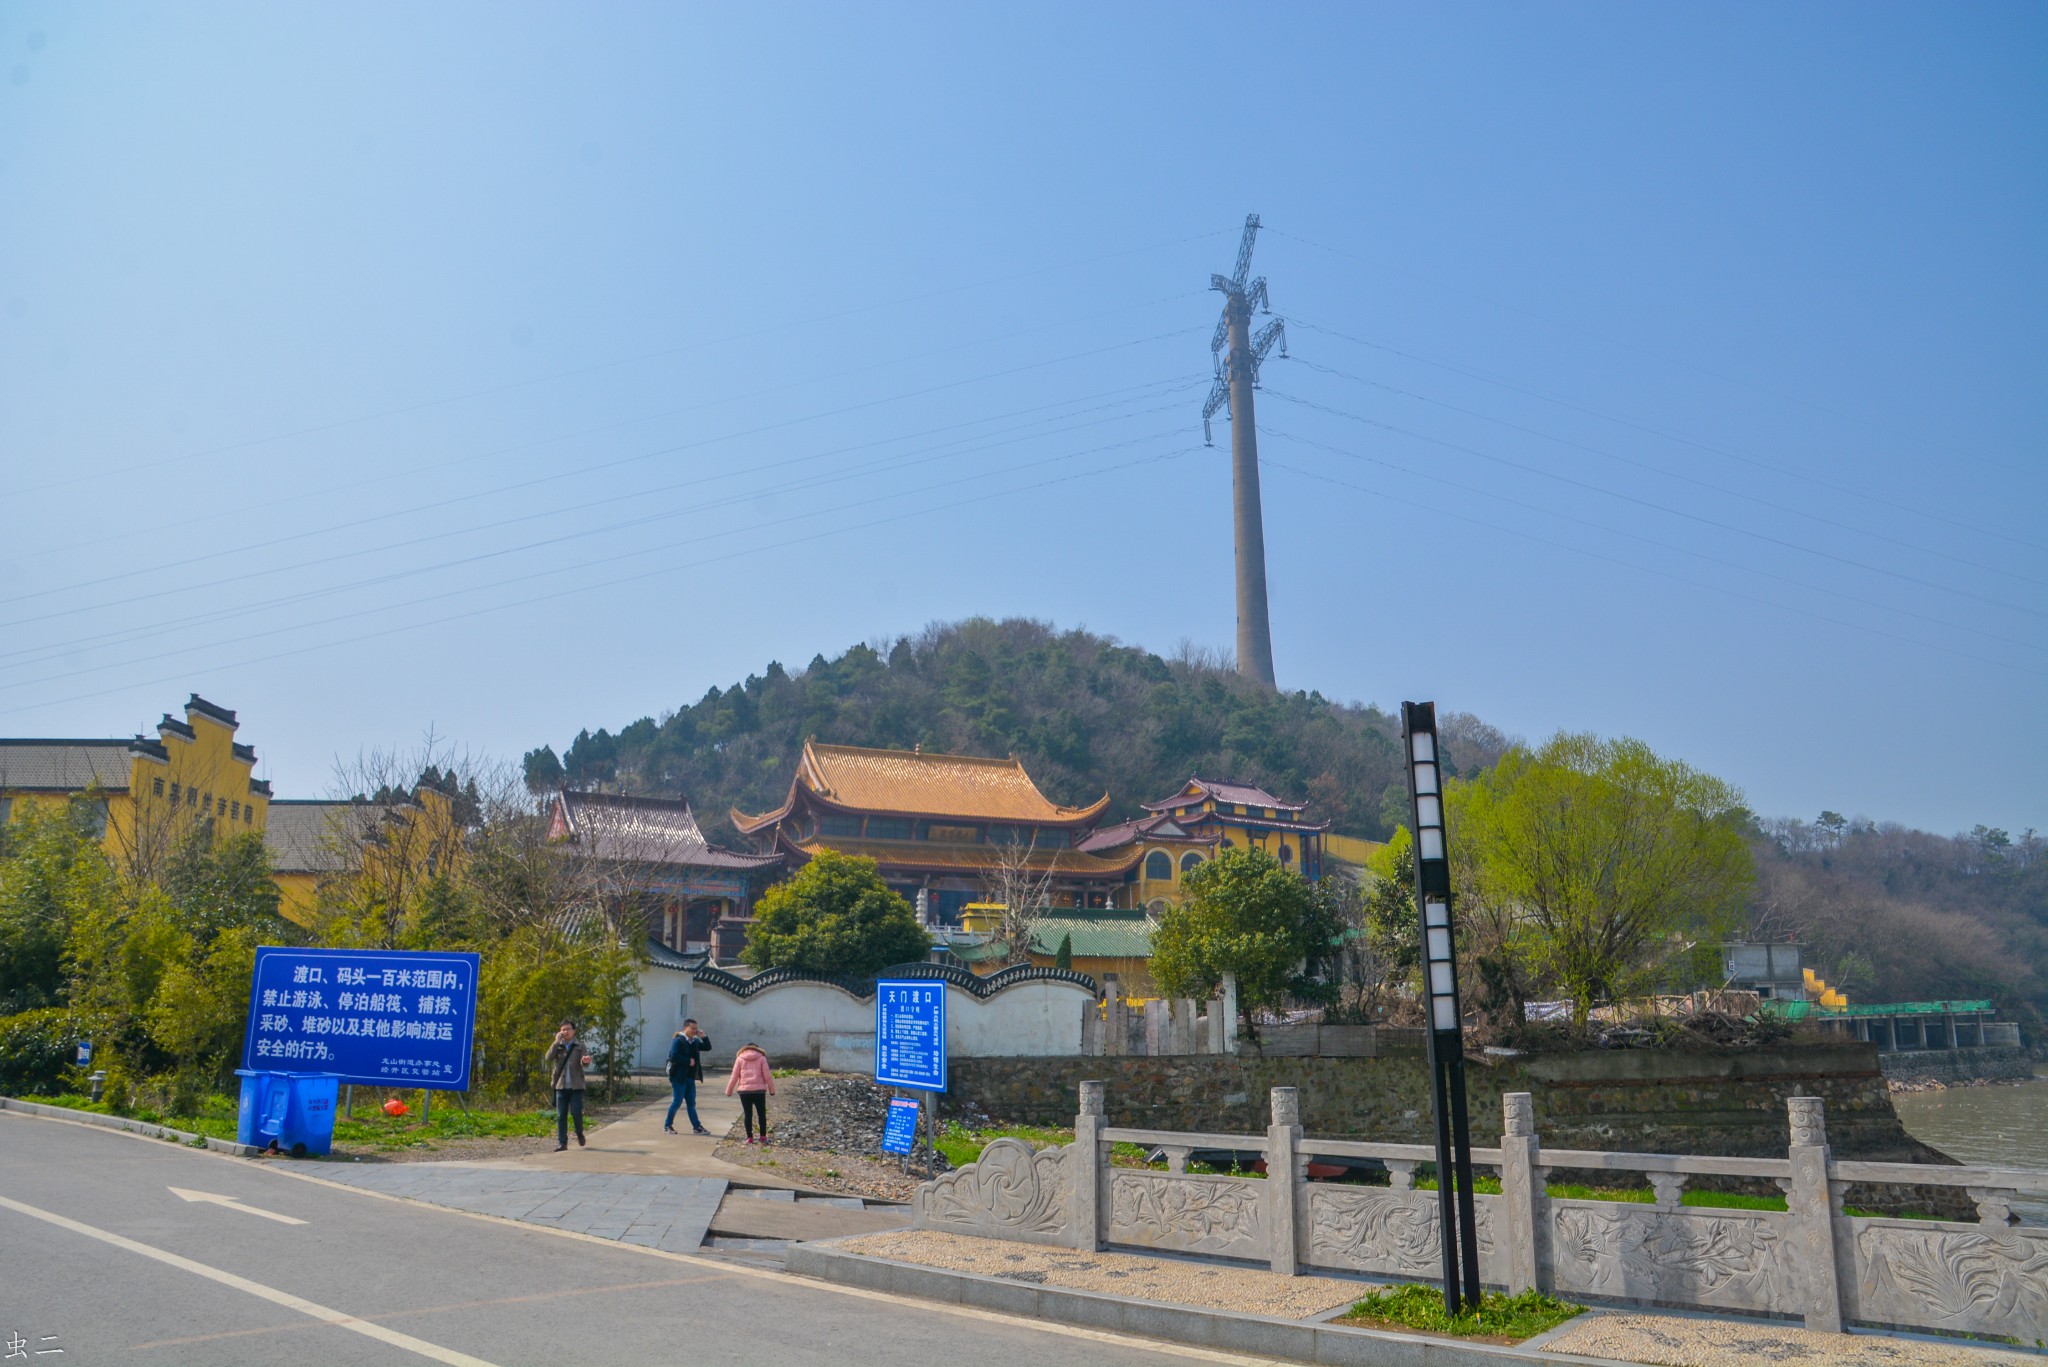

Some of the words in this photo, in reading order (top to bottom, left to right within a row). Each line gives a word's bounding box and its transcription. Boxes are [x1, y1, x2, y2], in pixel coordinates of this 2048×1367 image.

[262, 989, 459, 1016] 禁止游泳、停泊船筏、捕捞、
[889, 990, 931, 1003] 天门渡口
[260, 1014, 453, 1041] 采砂、堆砂以及其他影响渡运
[257, 1038, 335, 1061] 安全的行为。
